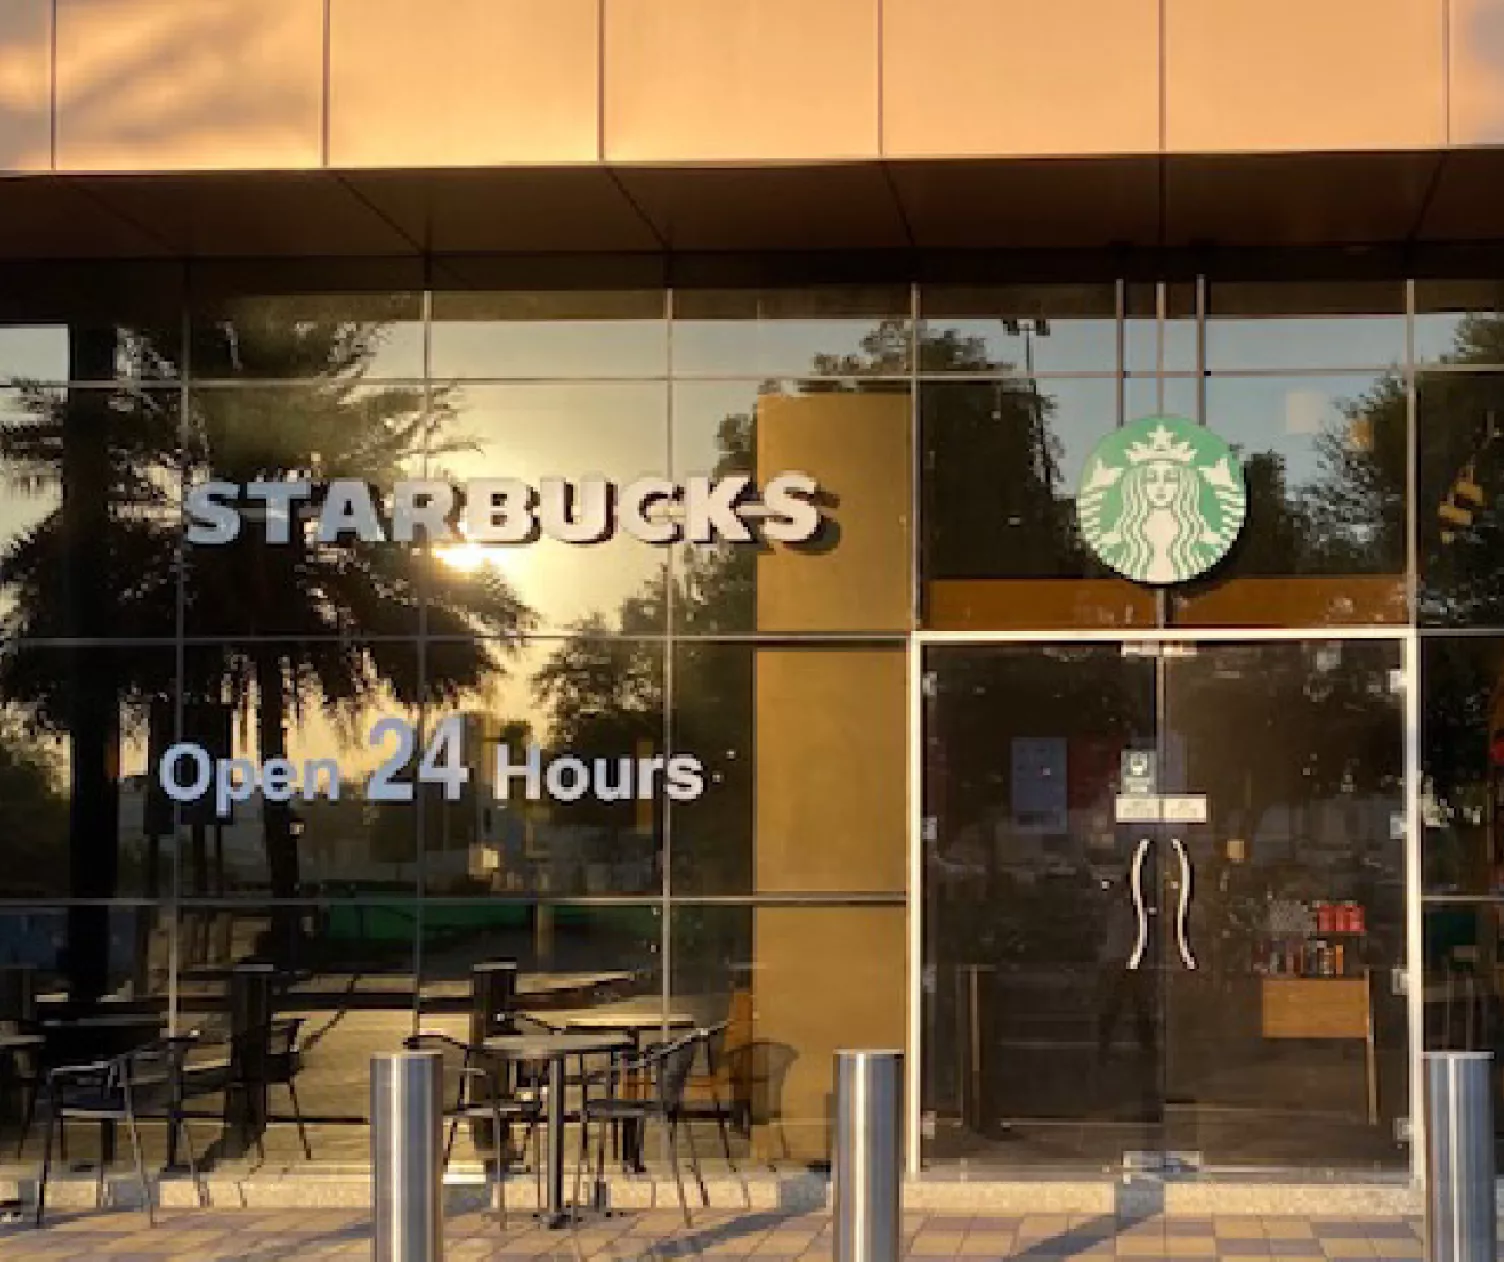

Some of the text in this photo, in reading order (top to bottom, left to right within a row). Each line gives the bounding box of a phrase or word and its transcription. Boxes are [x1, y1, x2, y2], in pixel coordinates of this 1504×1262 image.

[184, 471, 820, 545] STARBUCKS
[159, 717, 704, 817] Open 24 Hours
